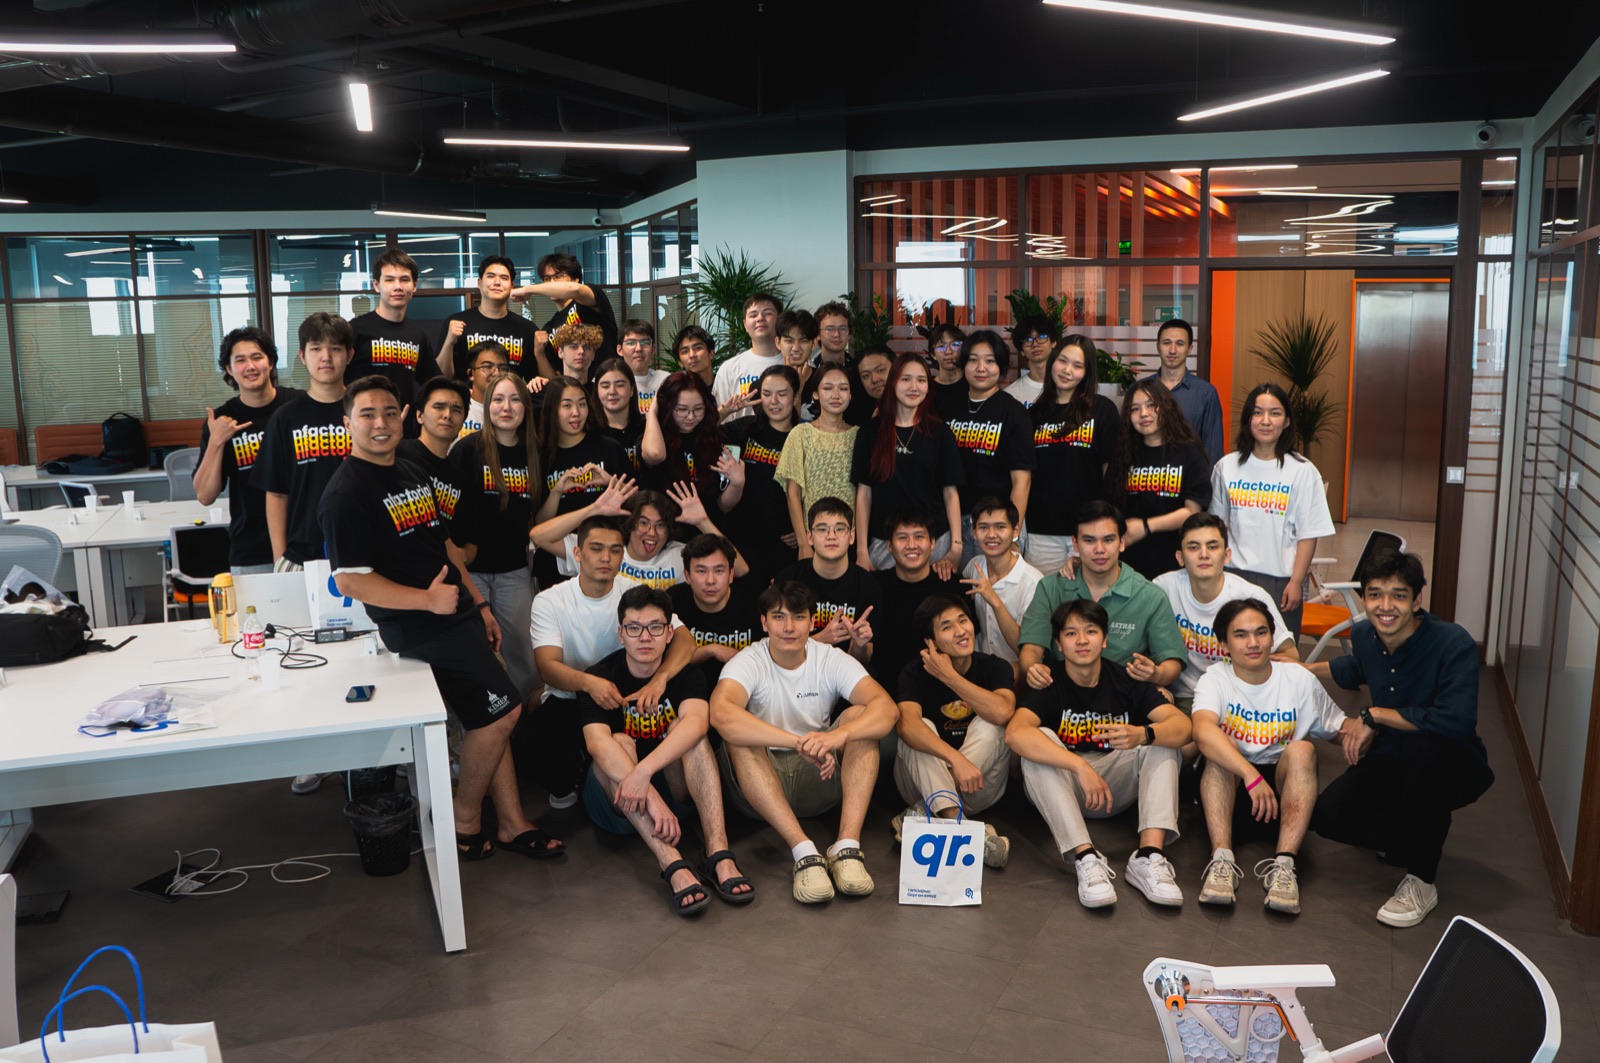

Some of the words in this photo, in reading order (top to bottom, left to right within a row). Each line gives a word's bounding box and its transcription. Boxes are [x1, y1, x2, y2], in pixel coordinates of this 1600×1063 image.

[1229, 479, 1290, 494] nfactoria
[620, 562, 676, 580] factorial
[1110, 622, 1136, 630] ASTRAL
[690, 627, 752, 645] factorial
[488, 695, 508, 713] KIMEP
[912, 833, 976, 877] qr.
